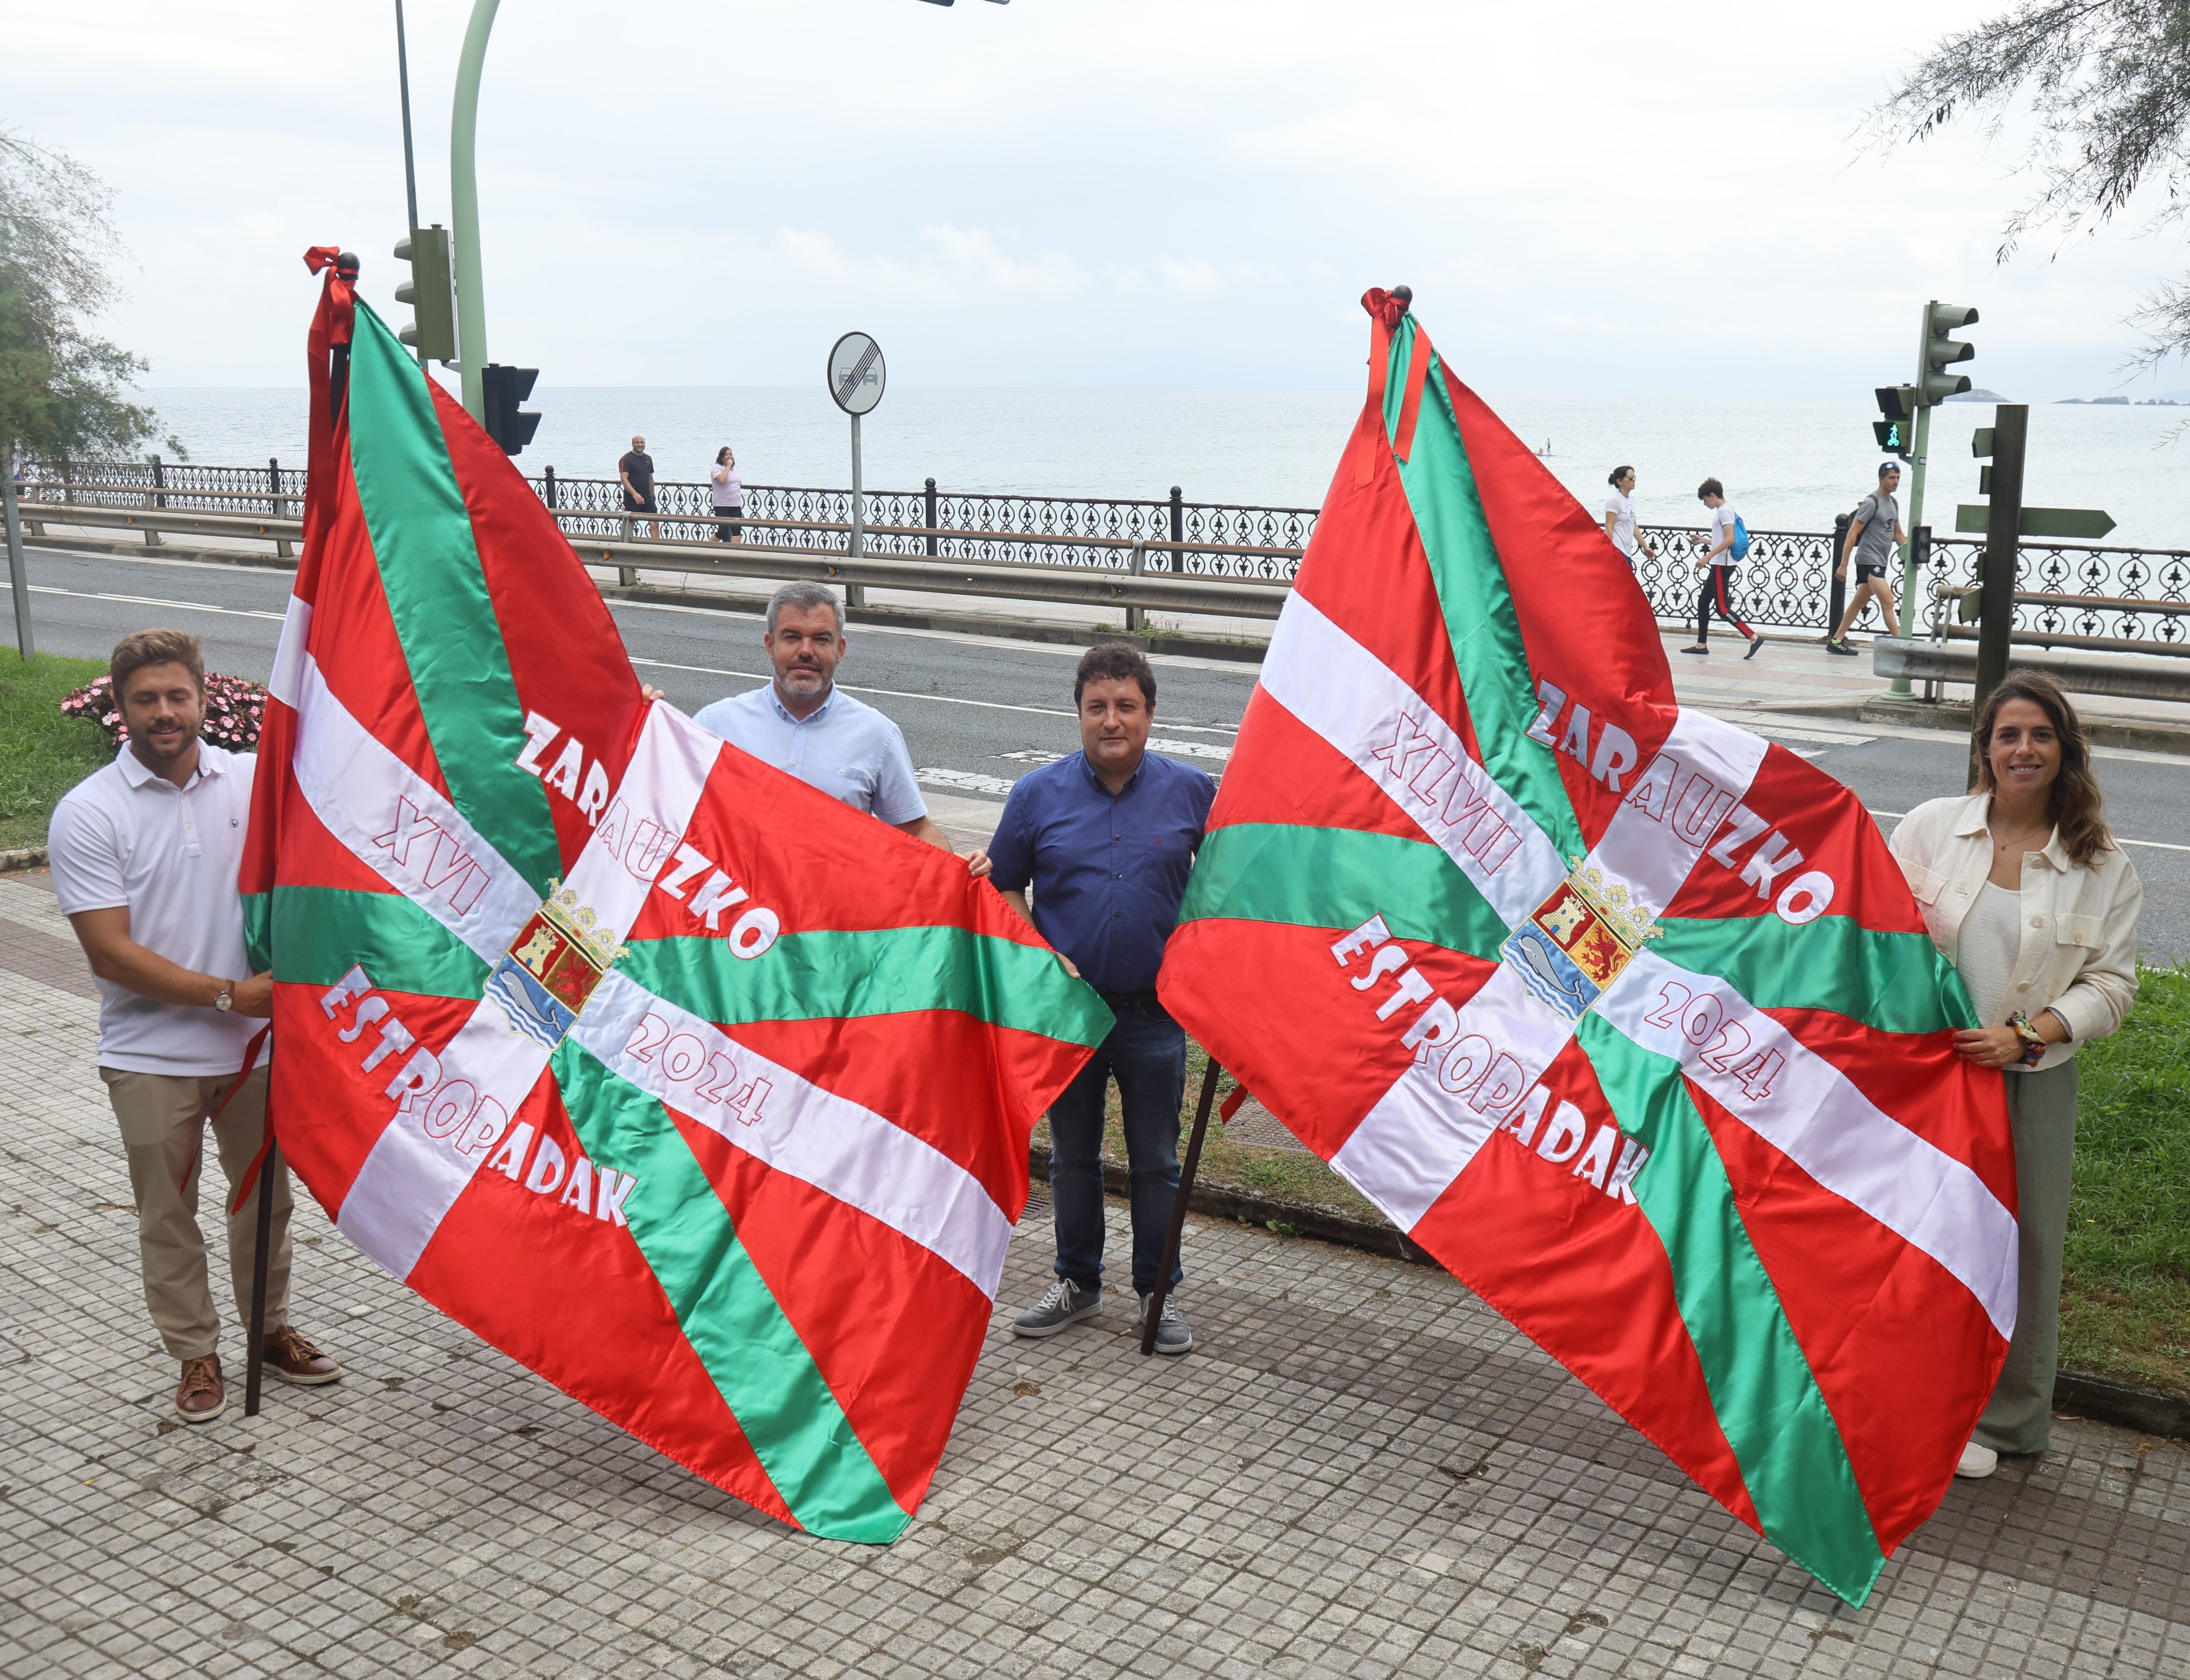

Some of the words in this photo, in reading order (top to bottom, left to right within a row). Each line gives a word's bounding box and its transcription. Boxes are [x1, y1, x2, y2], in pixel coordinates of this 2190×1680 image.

[373, 795, 491, 916] XVI
[514, 709, 780, 960] ZARAUZKO
[1371, 712, 1522, 876] XLVII
[1525, 678, 1835, 925] ZARAUZKO
[320, 962, 637, 1228] ESTROPADAK
[625, 1012, 773, 1127] 2024
[1329, 912, 1650, 1206] ESTROPADAK
[1644, 981, 1786, 1102] 2024
